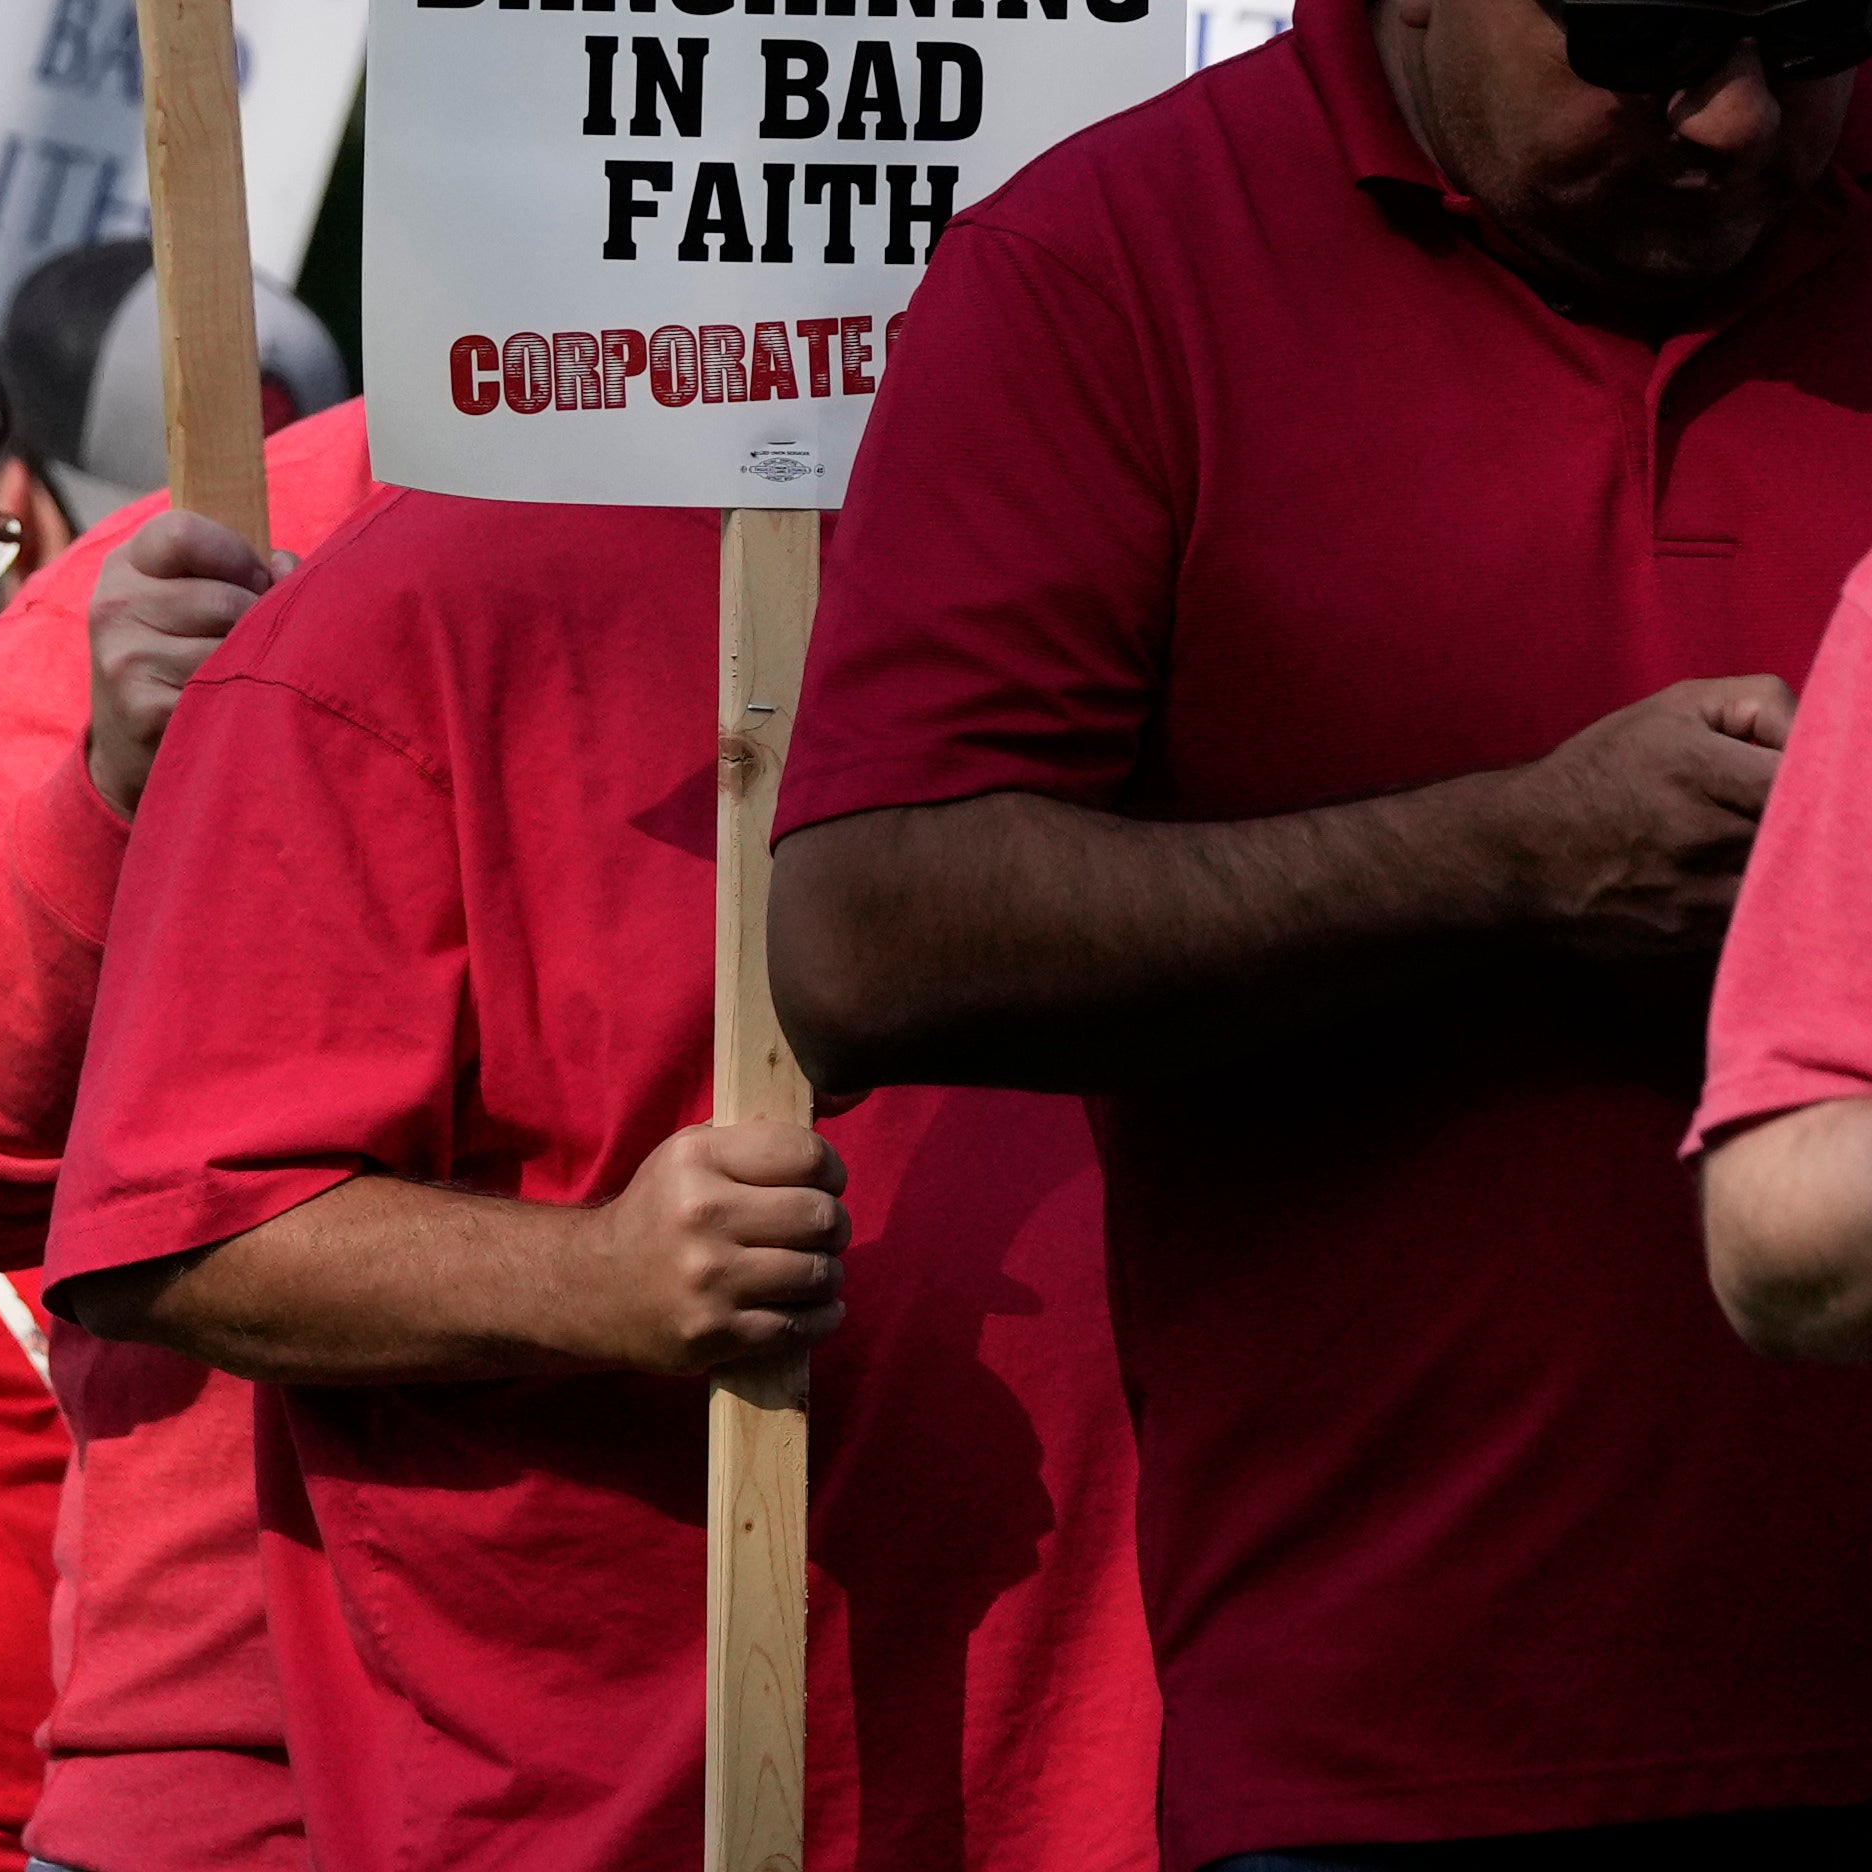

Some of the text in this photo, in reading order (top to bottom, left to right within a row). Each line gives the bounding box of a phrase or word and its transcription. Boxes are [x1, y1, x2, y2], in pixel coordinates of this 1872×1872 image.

[582, 36, 984, 142] IN BAD
[603, 160, 959, 264] FAITH
[449, 315, 875, 416] CORPORATE
